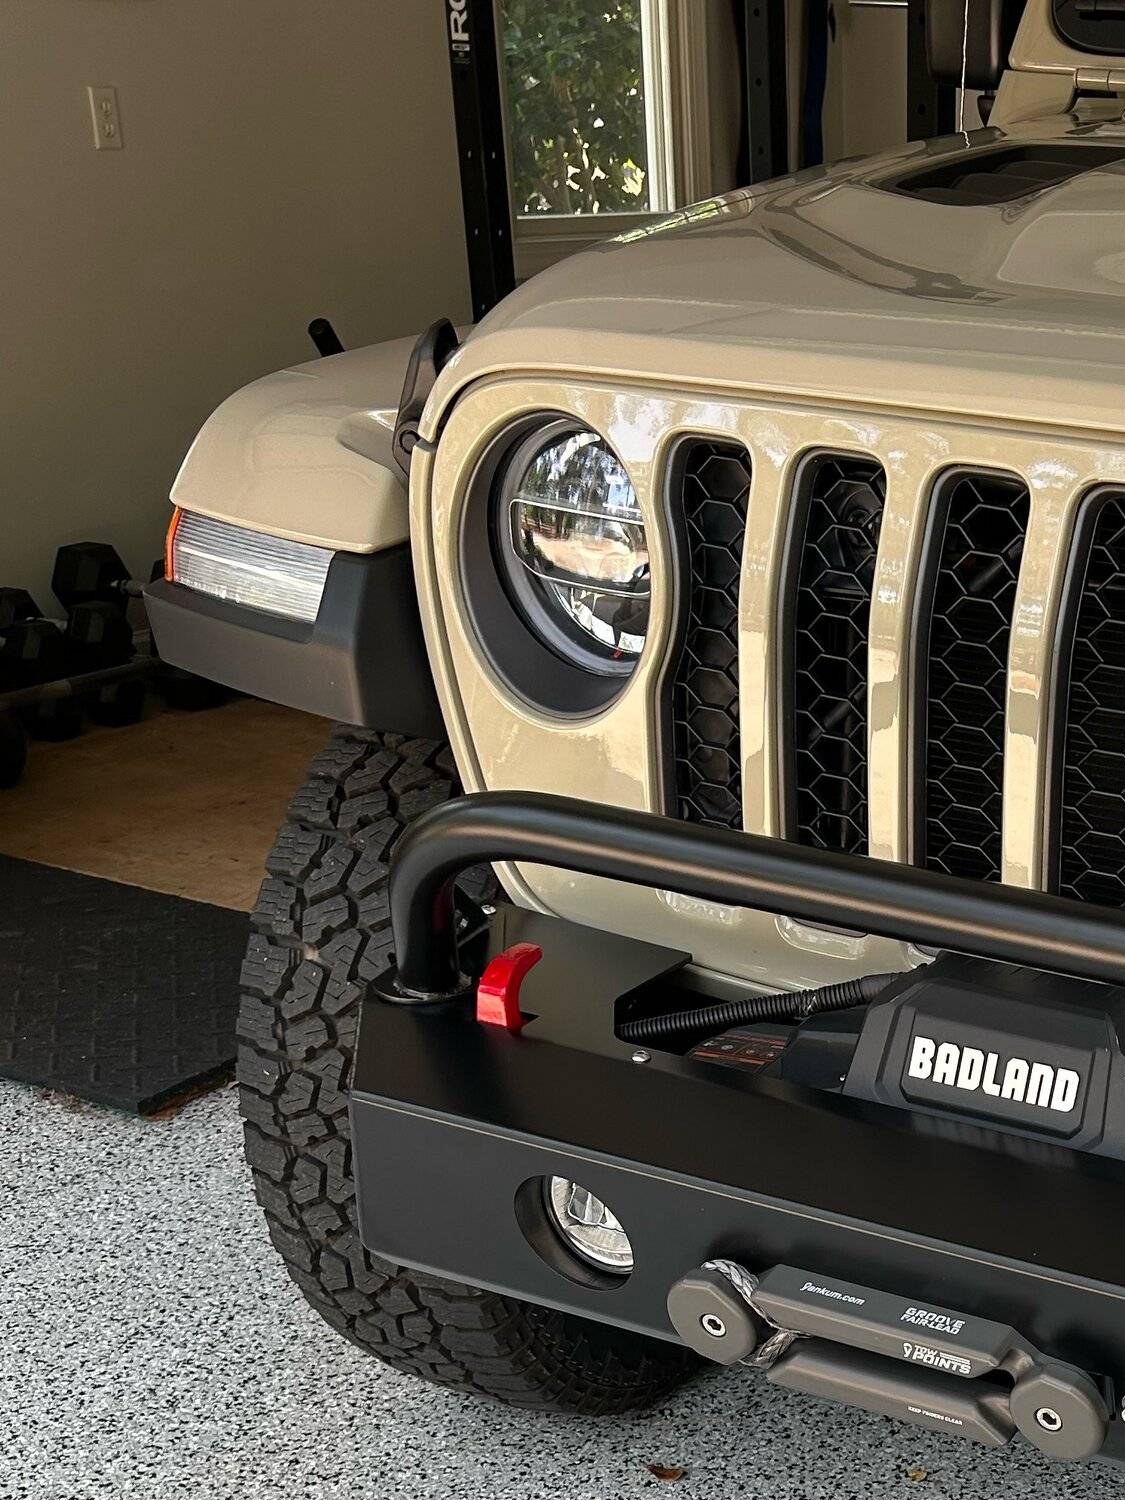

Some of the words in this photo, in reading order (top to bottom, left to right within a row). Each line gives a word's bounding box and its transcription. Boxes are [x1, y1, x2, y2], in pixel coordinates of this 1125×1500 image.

[908, 1035, 1080, 1113] BADLAND
[905, 1307, 966, 1329] GROOVE
[914, 1344, 938, 1356] TOW
[912, 1351, 972, 1375] POINTS
